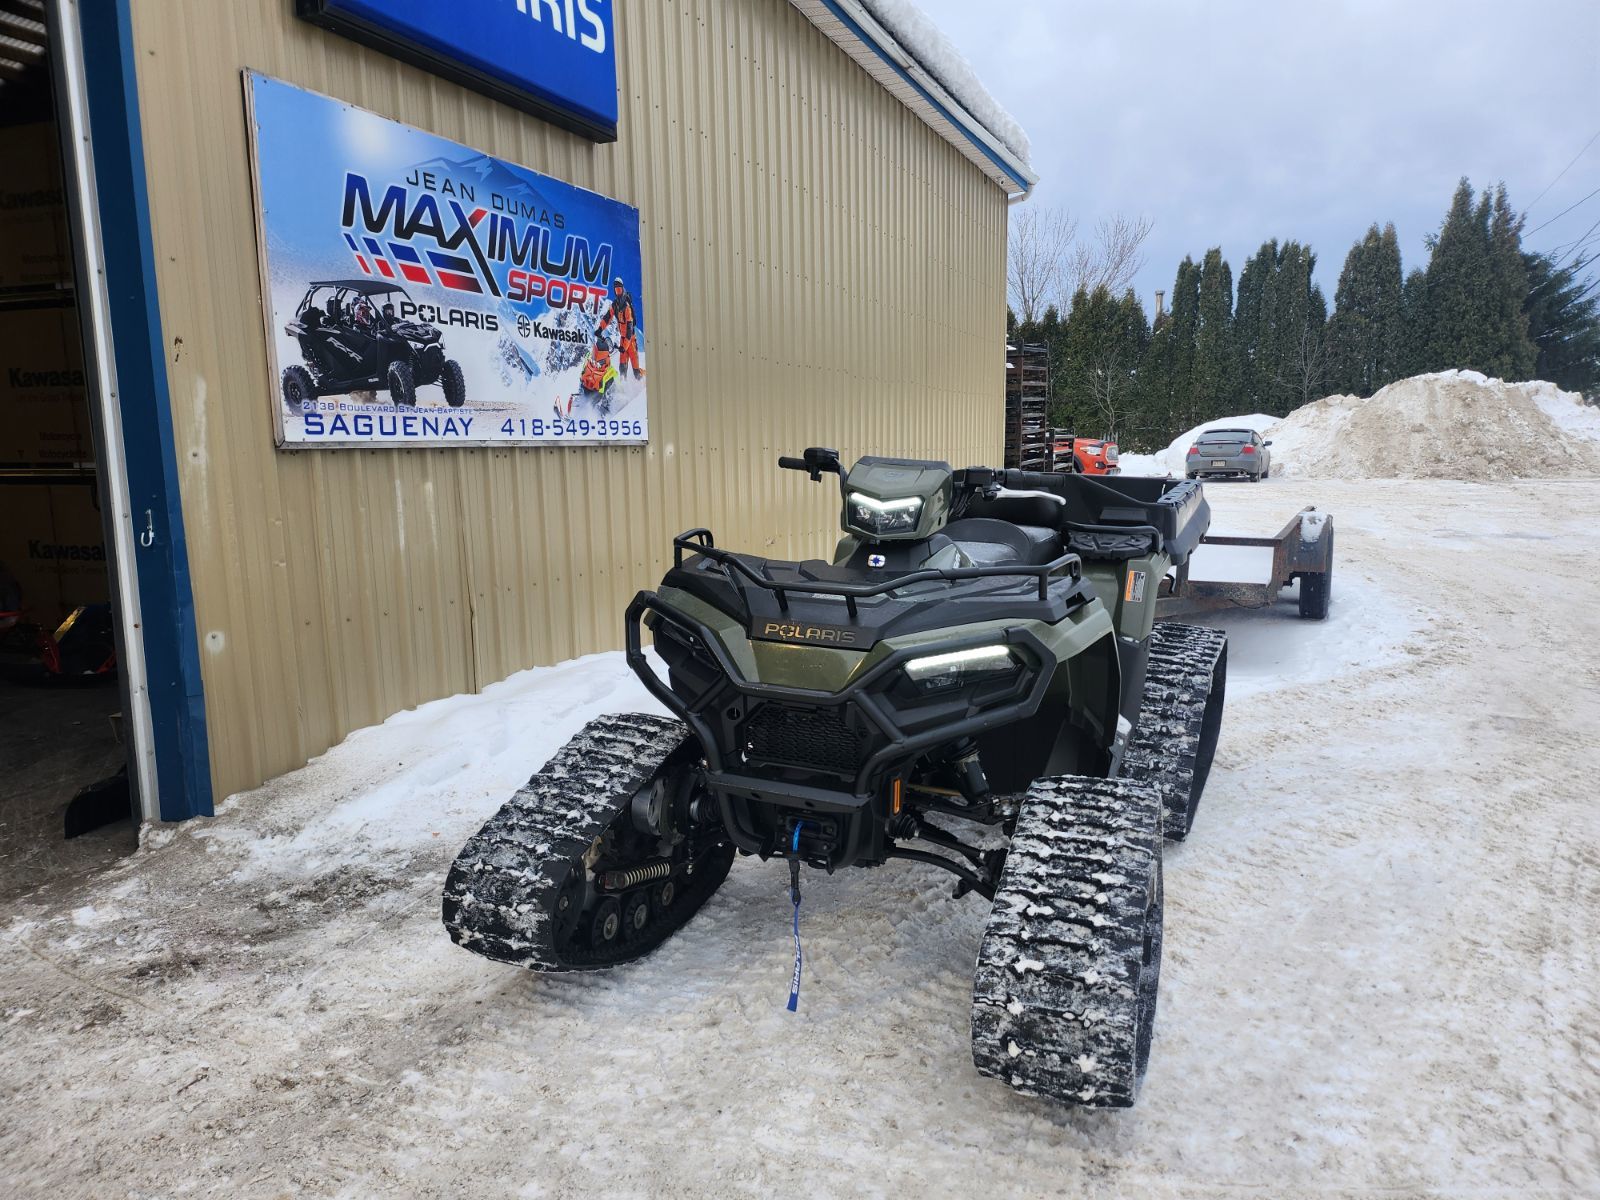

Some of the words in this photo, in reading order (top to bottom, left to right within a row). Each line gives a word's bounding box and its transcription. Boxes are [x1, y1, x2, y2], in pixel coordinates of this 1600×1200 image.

[516, 0, 606, 54] RIS
[406, 169, 475, 203] JEAN
[491, 192, 565, 230] DUMAS
[341, 172, 613, 298] MAXIMUM
[506, 268, 608, 315] SPORT
[400, 301, 499, 332] POLARIS
[533, 321, 588, 344] Kawasaki
[8, 367, 85, 389] Kawasa
[304, 413, 474, 437] SAGUENAY
[500, 418, 643, 437] 418-549-3956
[764, 623, 857, 643] POLARIS
